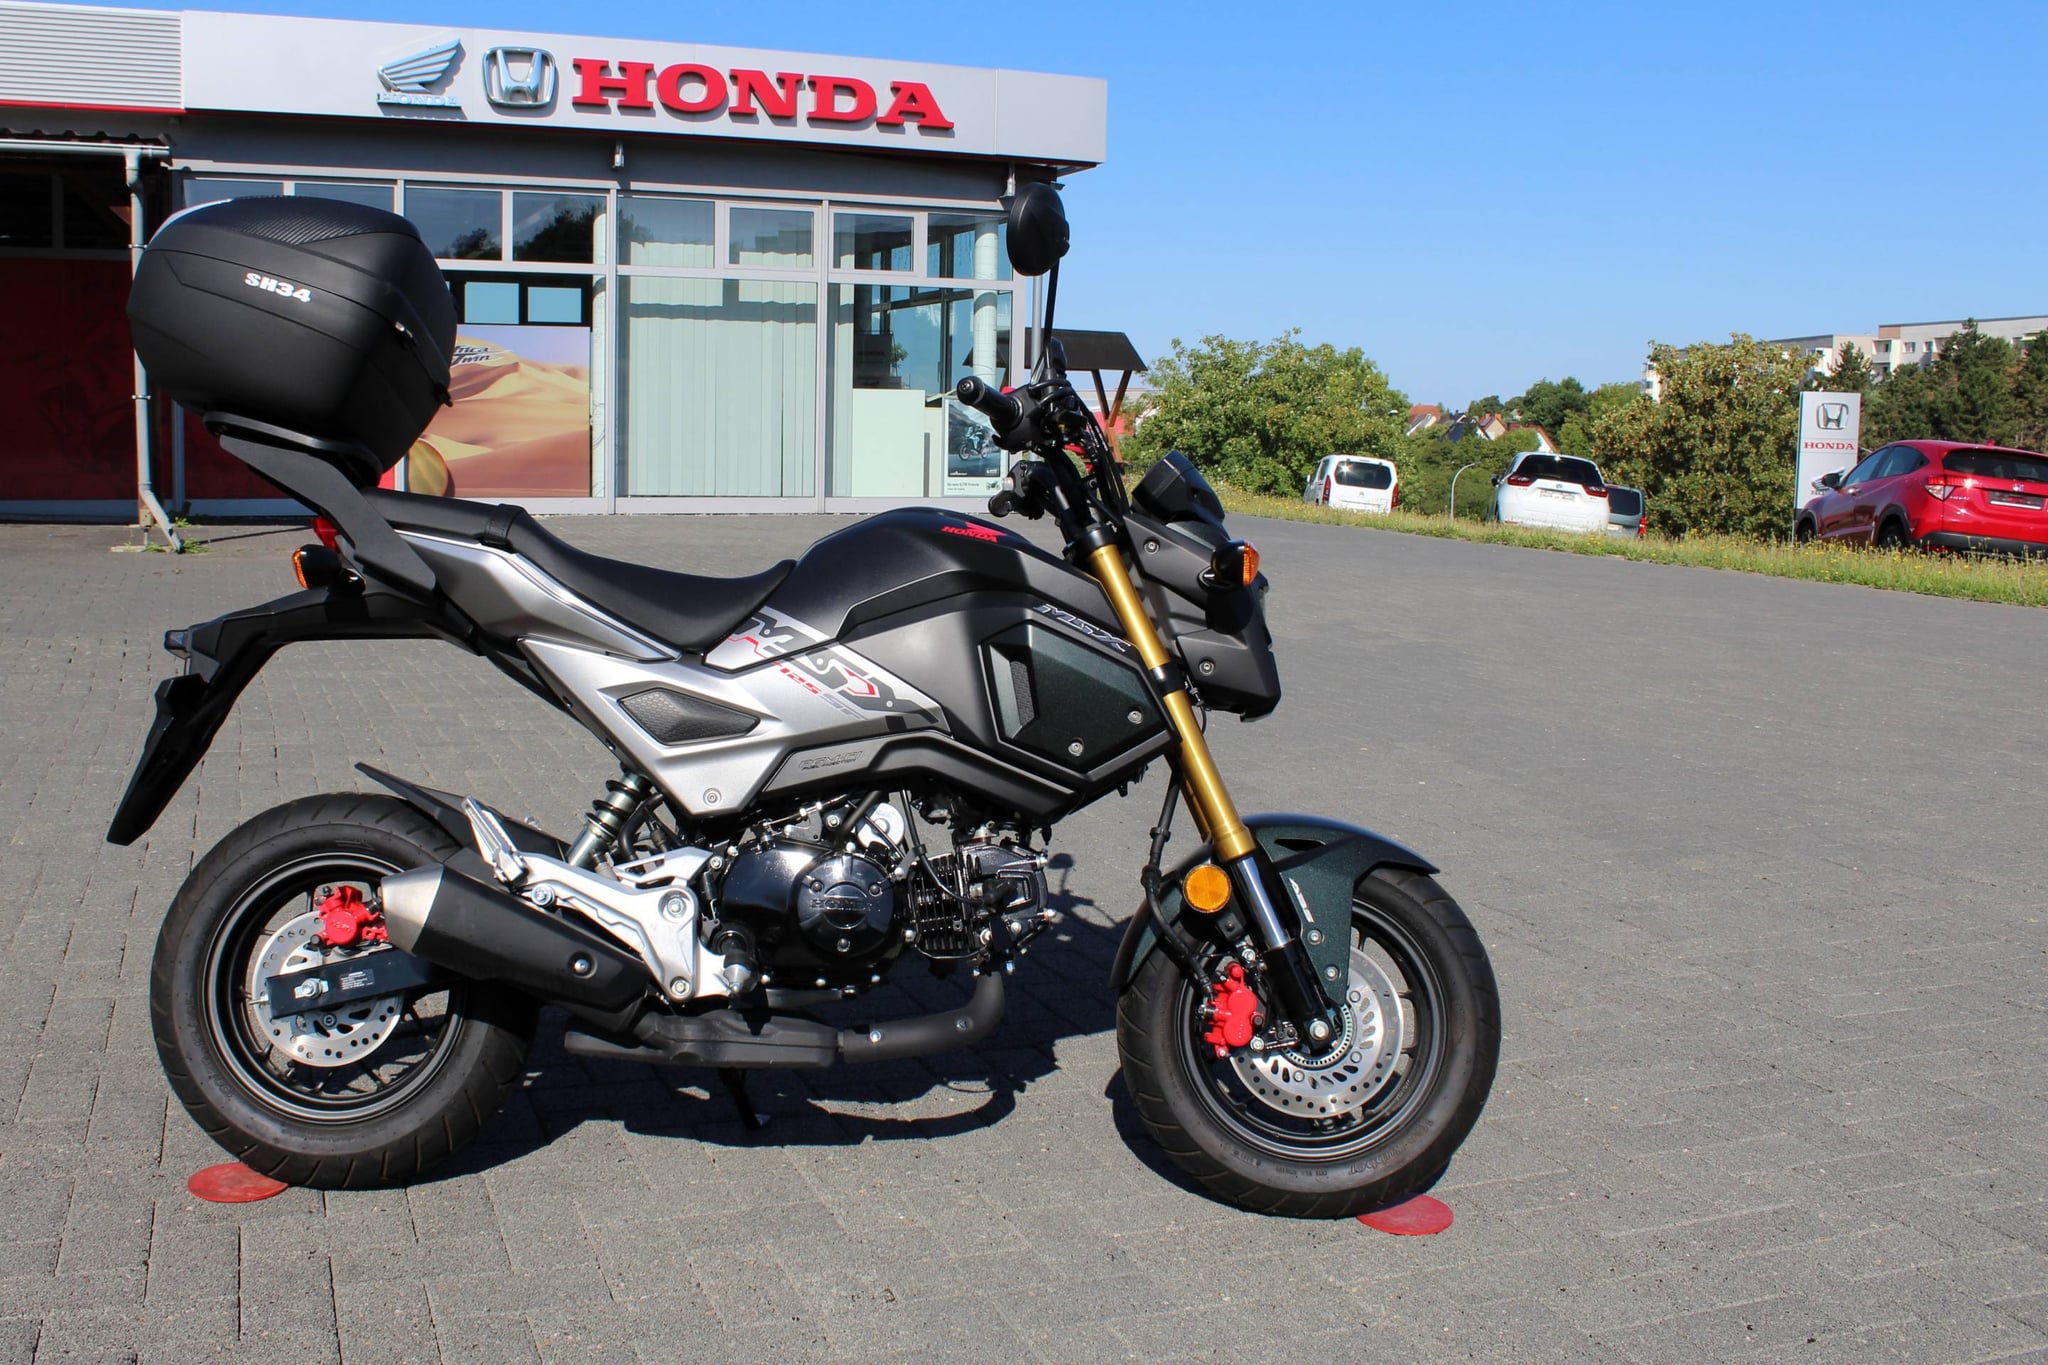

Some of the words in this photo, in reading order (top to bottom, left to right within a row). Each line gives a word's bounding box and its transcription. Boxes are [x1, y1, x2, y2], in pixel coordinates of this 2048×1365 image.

[377, 93, 460, 107] HONDA
[572, 58, 955, 129] HONDA
[244, 272, 312, 303] SH34
[1804, 442, 1855, 450] HONDA
[941, 526, 999, 543] HONDA
[1034, 603, 1132, 653] MSX
